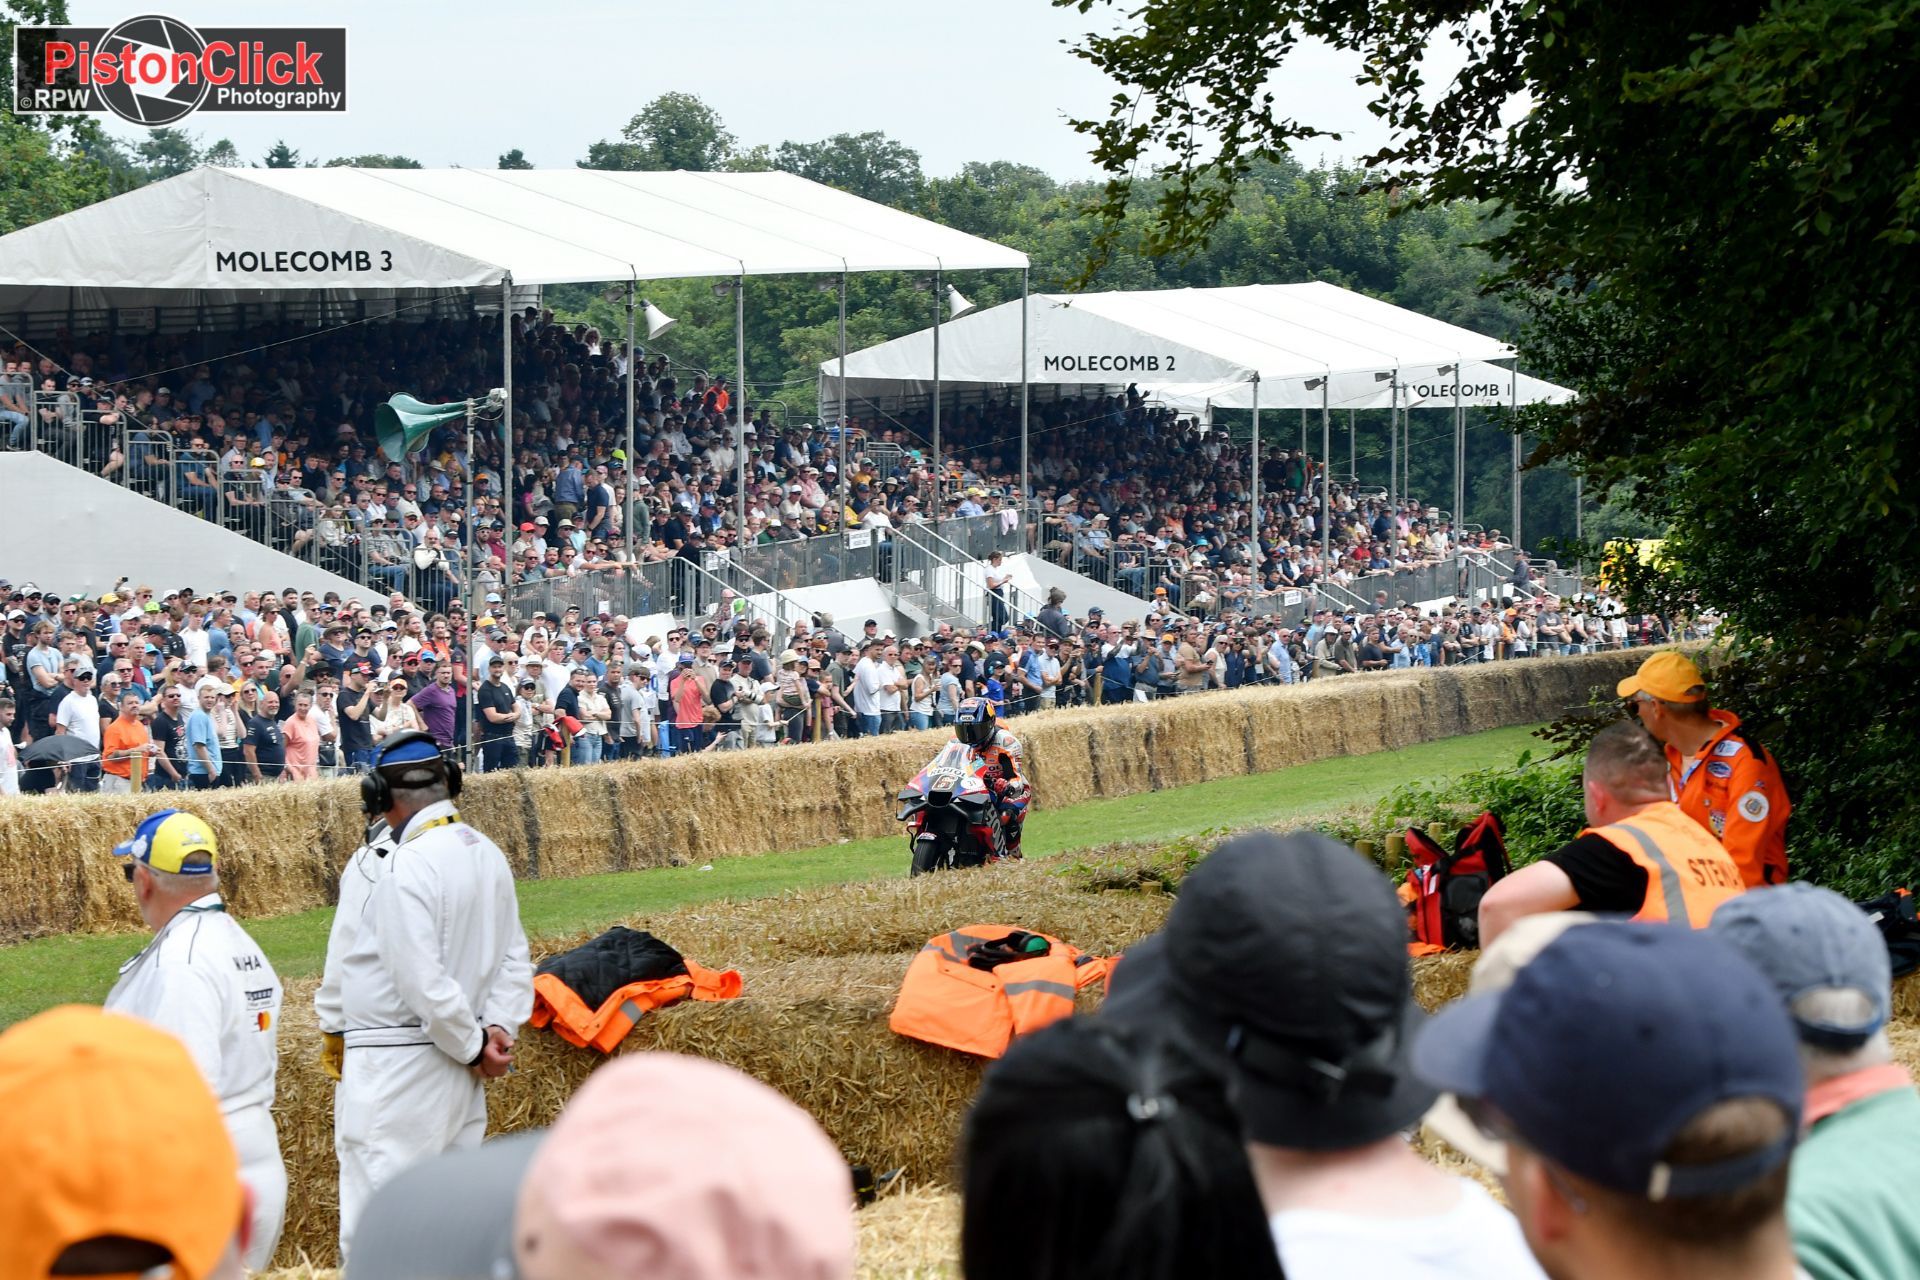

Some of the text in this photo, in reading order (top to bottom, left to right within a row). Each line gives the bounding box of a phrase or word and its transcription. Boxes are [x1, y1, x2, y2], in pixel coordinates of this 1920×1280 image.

[216, 250, 393, 272] MOLECOMB 3
[1044, 355, 1176, 371] MOLECOMB 2
